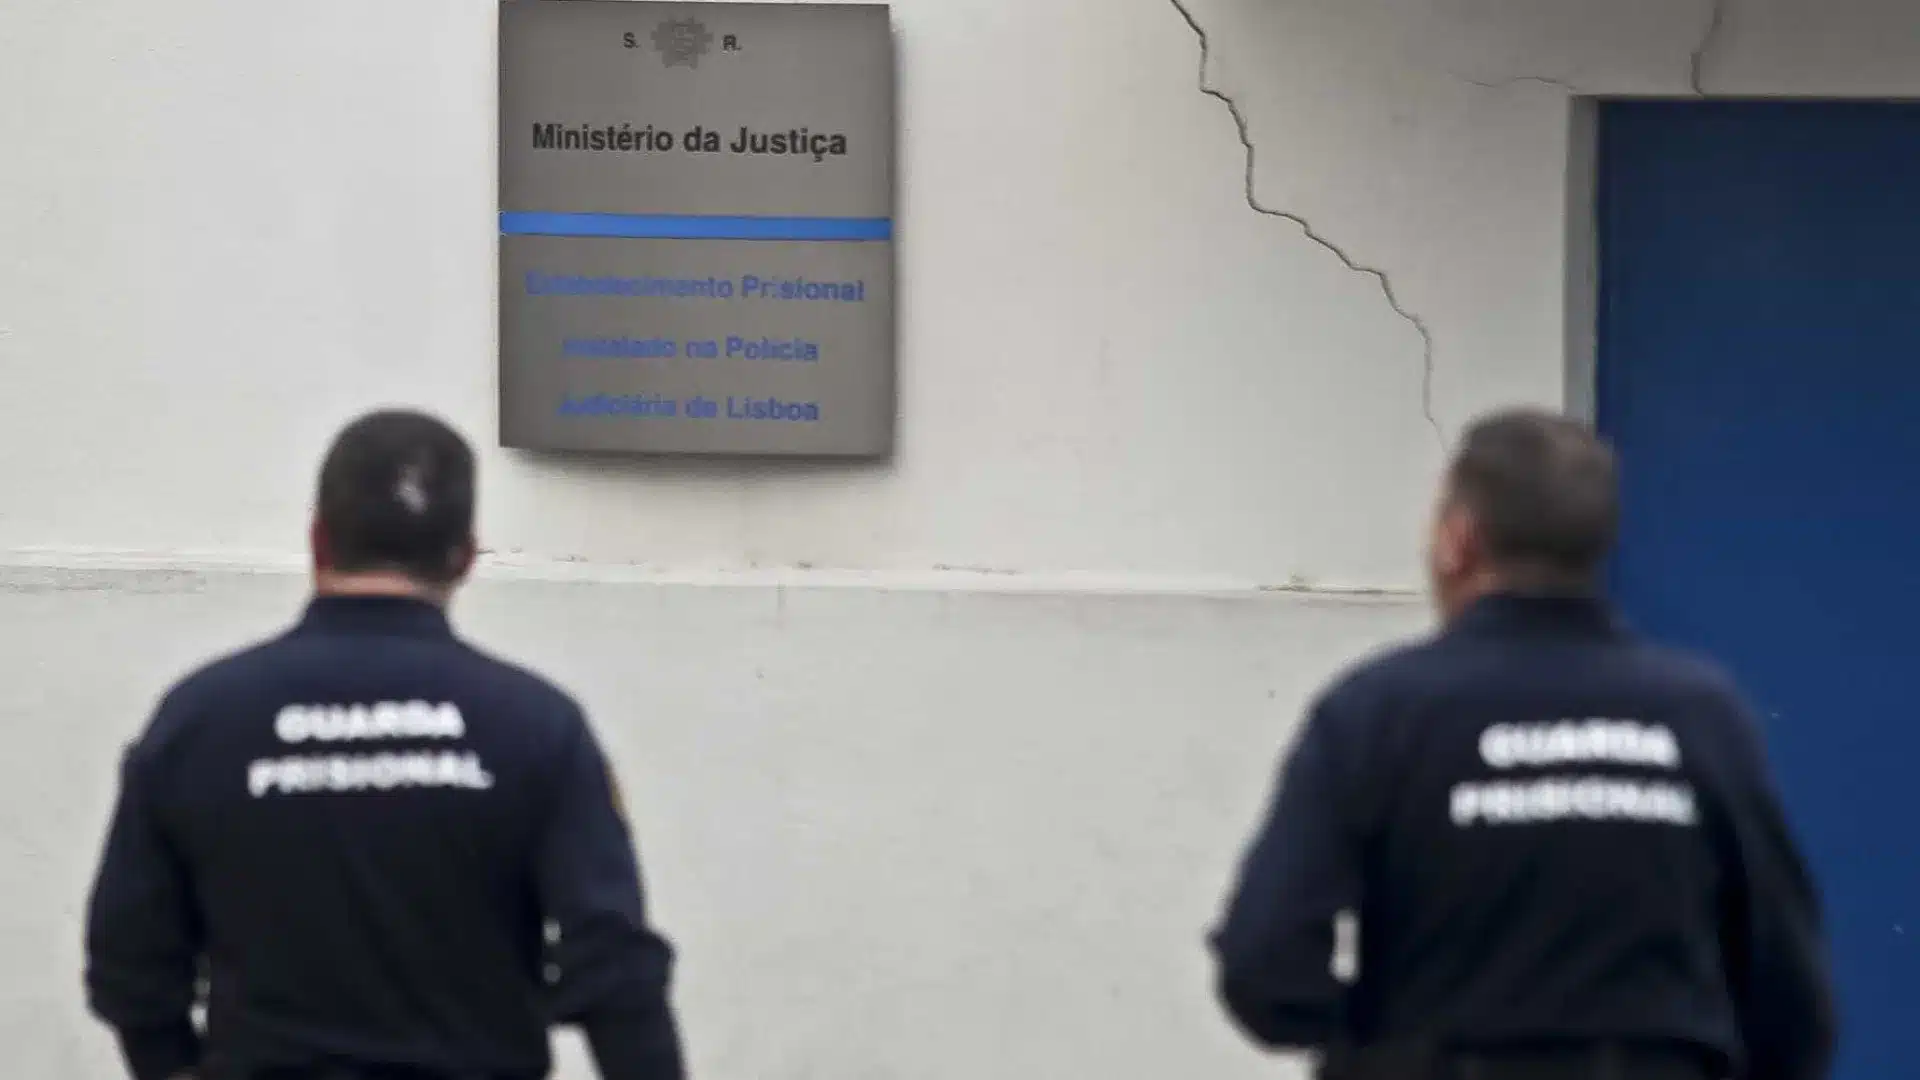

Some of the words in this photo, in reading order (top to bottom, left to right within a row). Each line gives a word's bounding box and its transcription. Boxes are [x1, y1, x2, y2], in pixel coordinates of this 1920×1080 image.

[623, 32, 640, 49] S.
[722, 34, 742, 52] R.
[532, 122, 674, 153] Ministério
[683, 126, 720, 153] da
[730, 127, 847, 163] Justiça
[740, 274, 865, 301] Prisional
[726, 396, 820, 421] Lisboa
